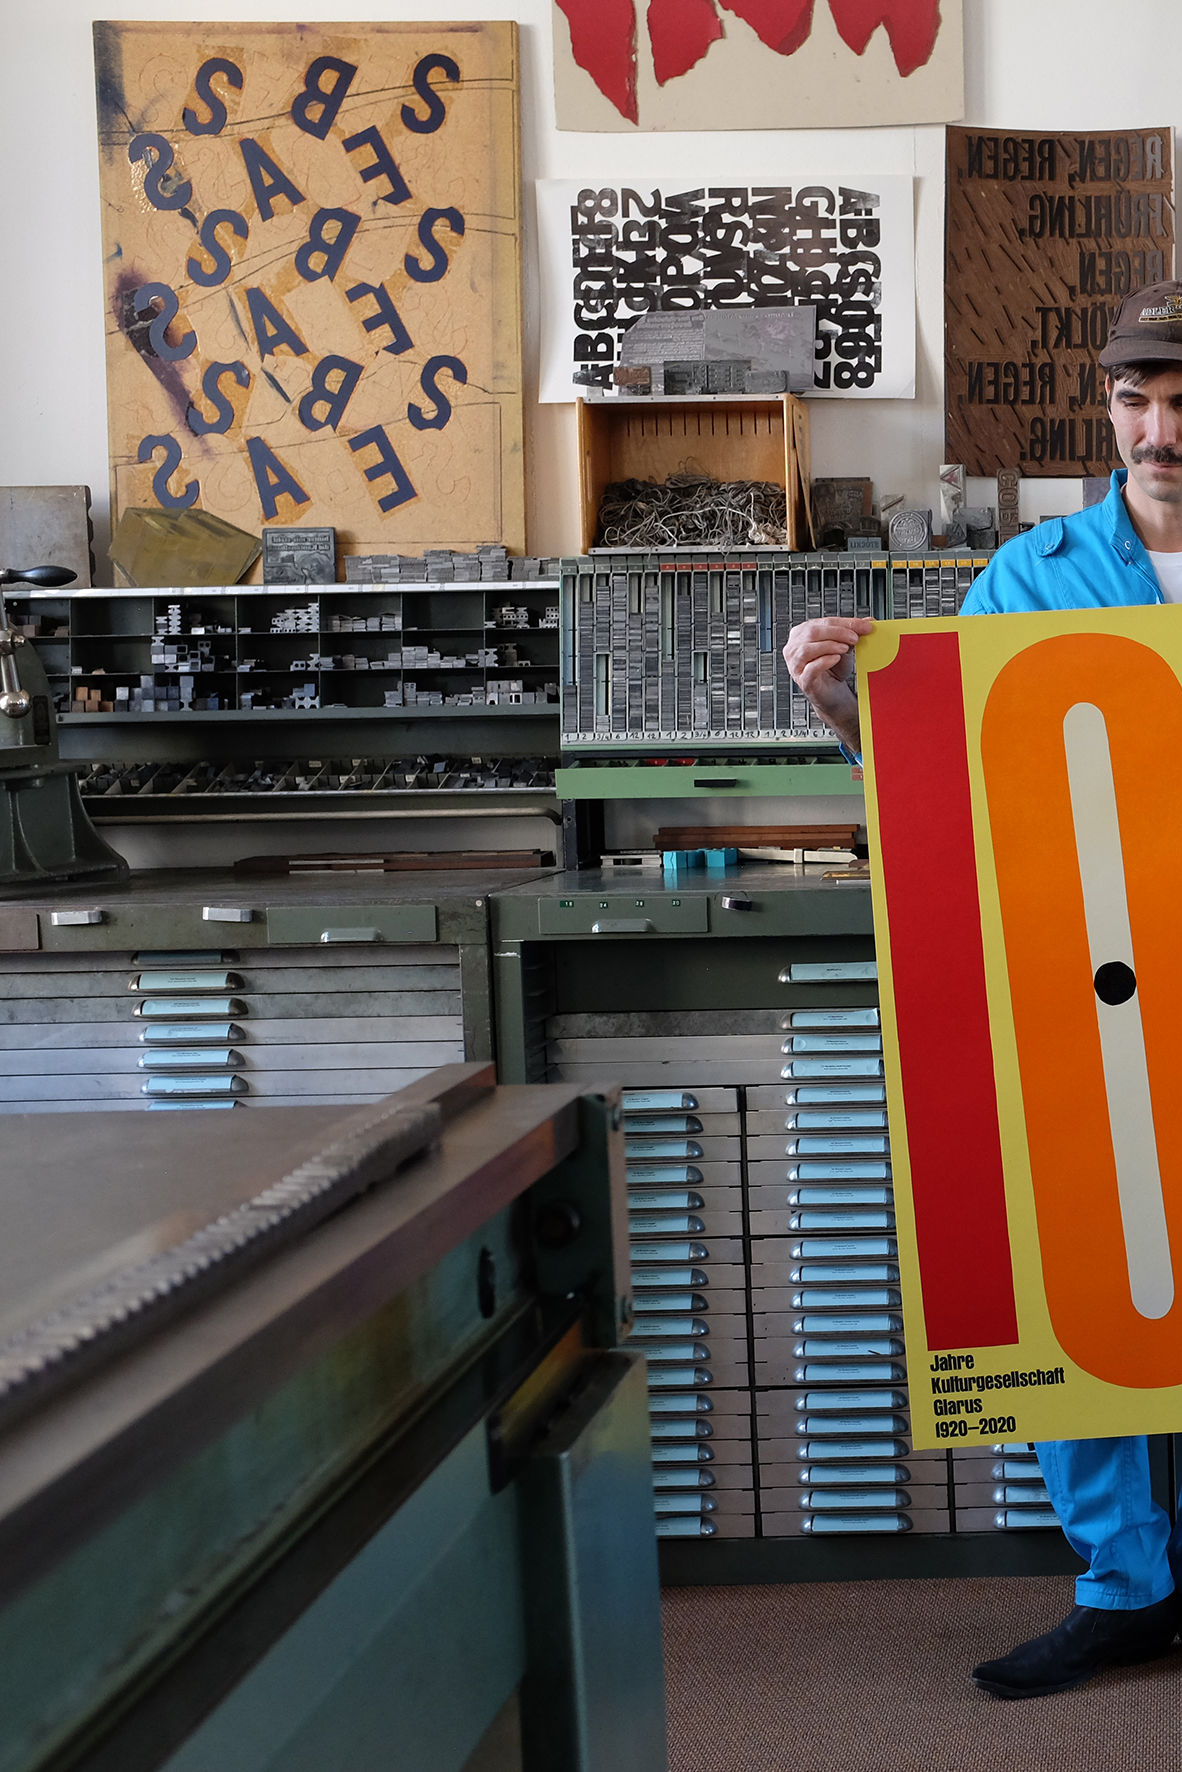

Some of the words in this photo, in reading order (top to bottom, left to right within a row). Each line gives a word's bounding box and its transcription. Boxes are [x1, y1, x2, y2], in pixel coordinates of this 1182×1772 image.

[930, 1354, 975, 1372] Jahre
[931, 1367, 1066, 1394] Kulturgesellschaft
[933, 1398, 983, 1416] Glarus
[935, 1416, 1017, 1438] 1920–2020
